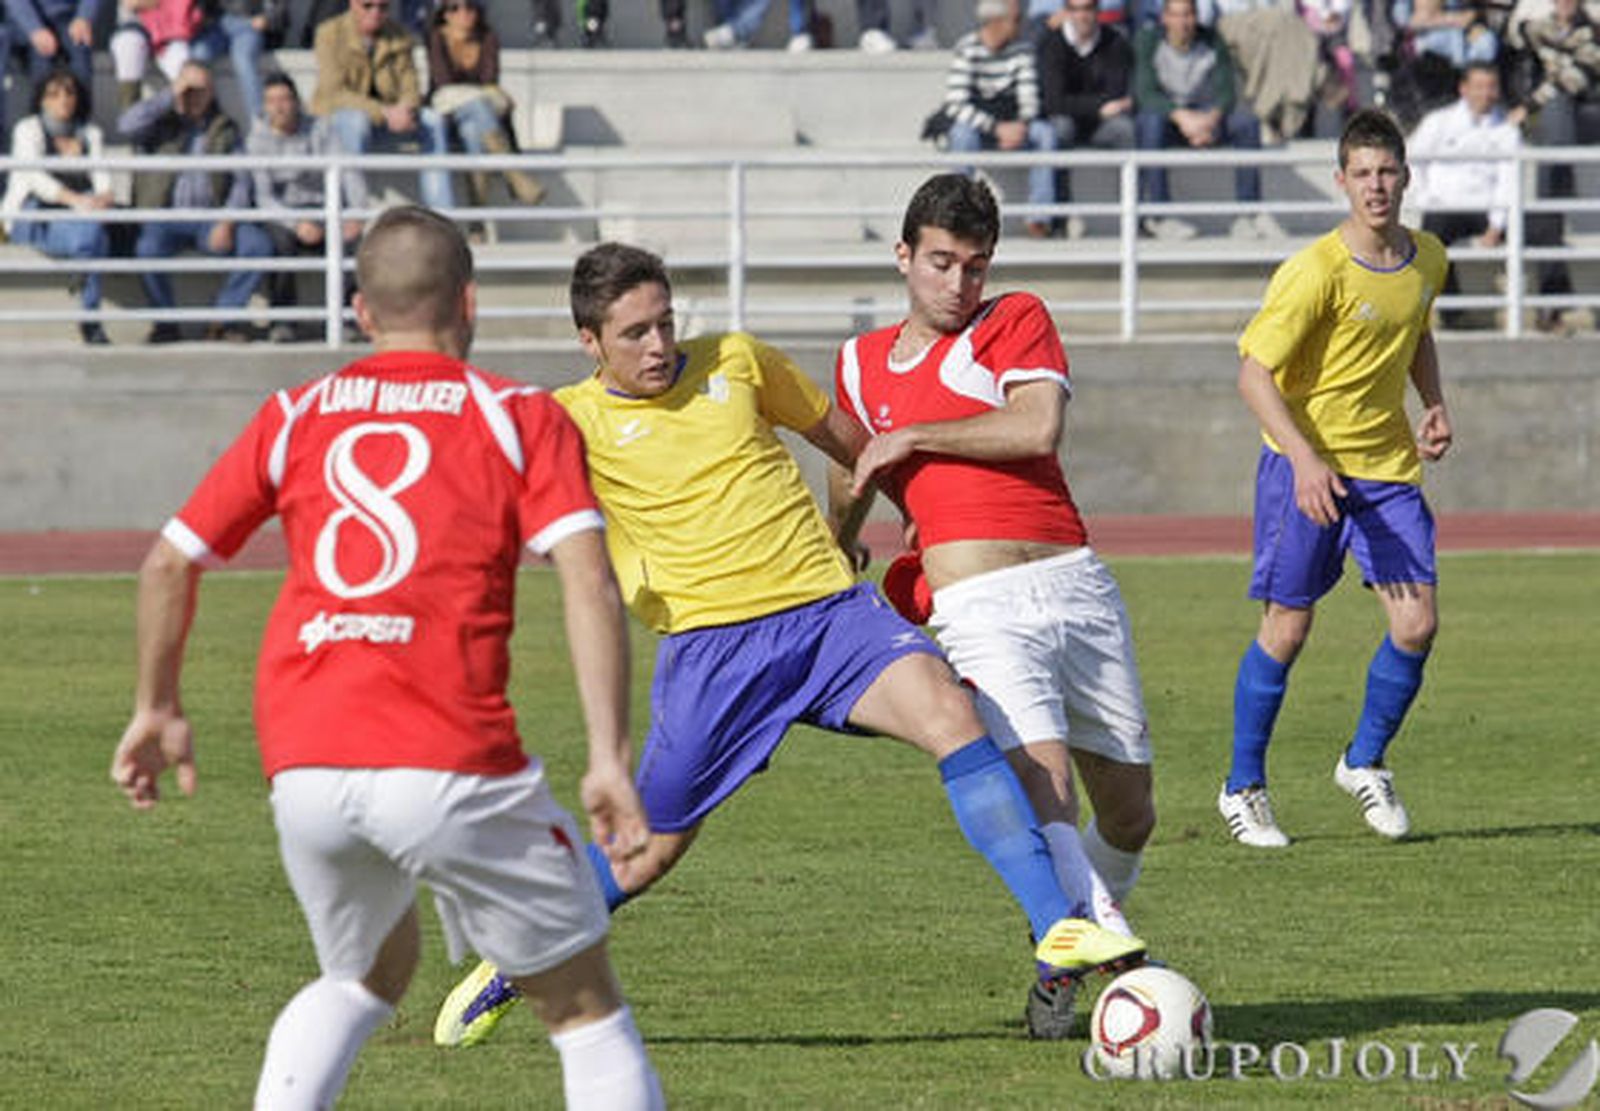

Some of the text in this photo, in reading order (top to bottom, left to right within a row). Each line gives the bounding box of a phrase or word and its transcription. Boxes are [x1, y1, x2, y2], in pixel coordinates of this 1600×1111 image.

[319, 376, 468, 417] LIAM WALKER
[313, 421, 431, 599] 8
